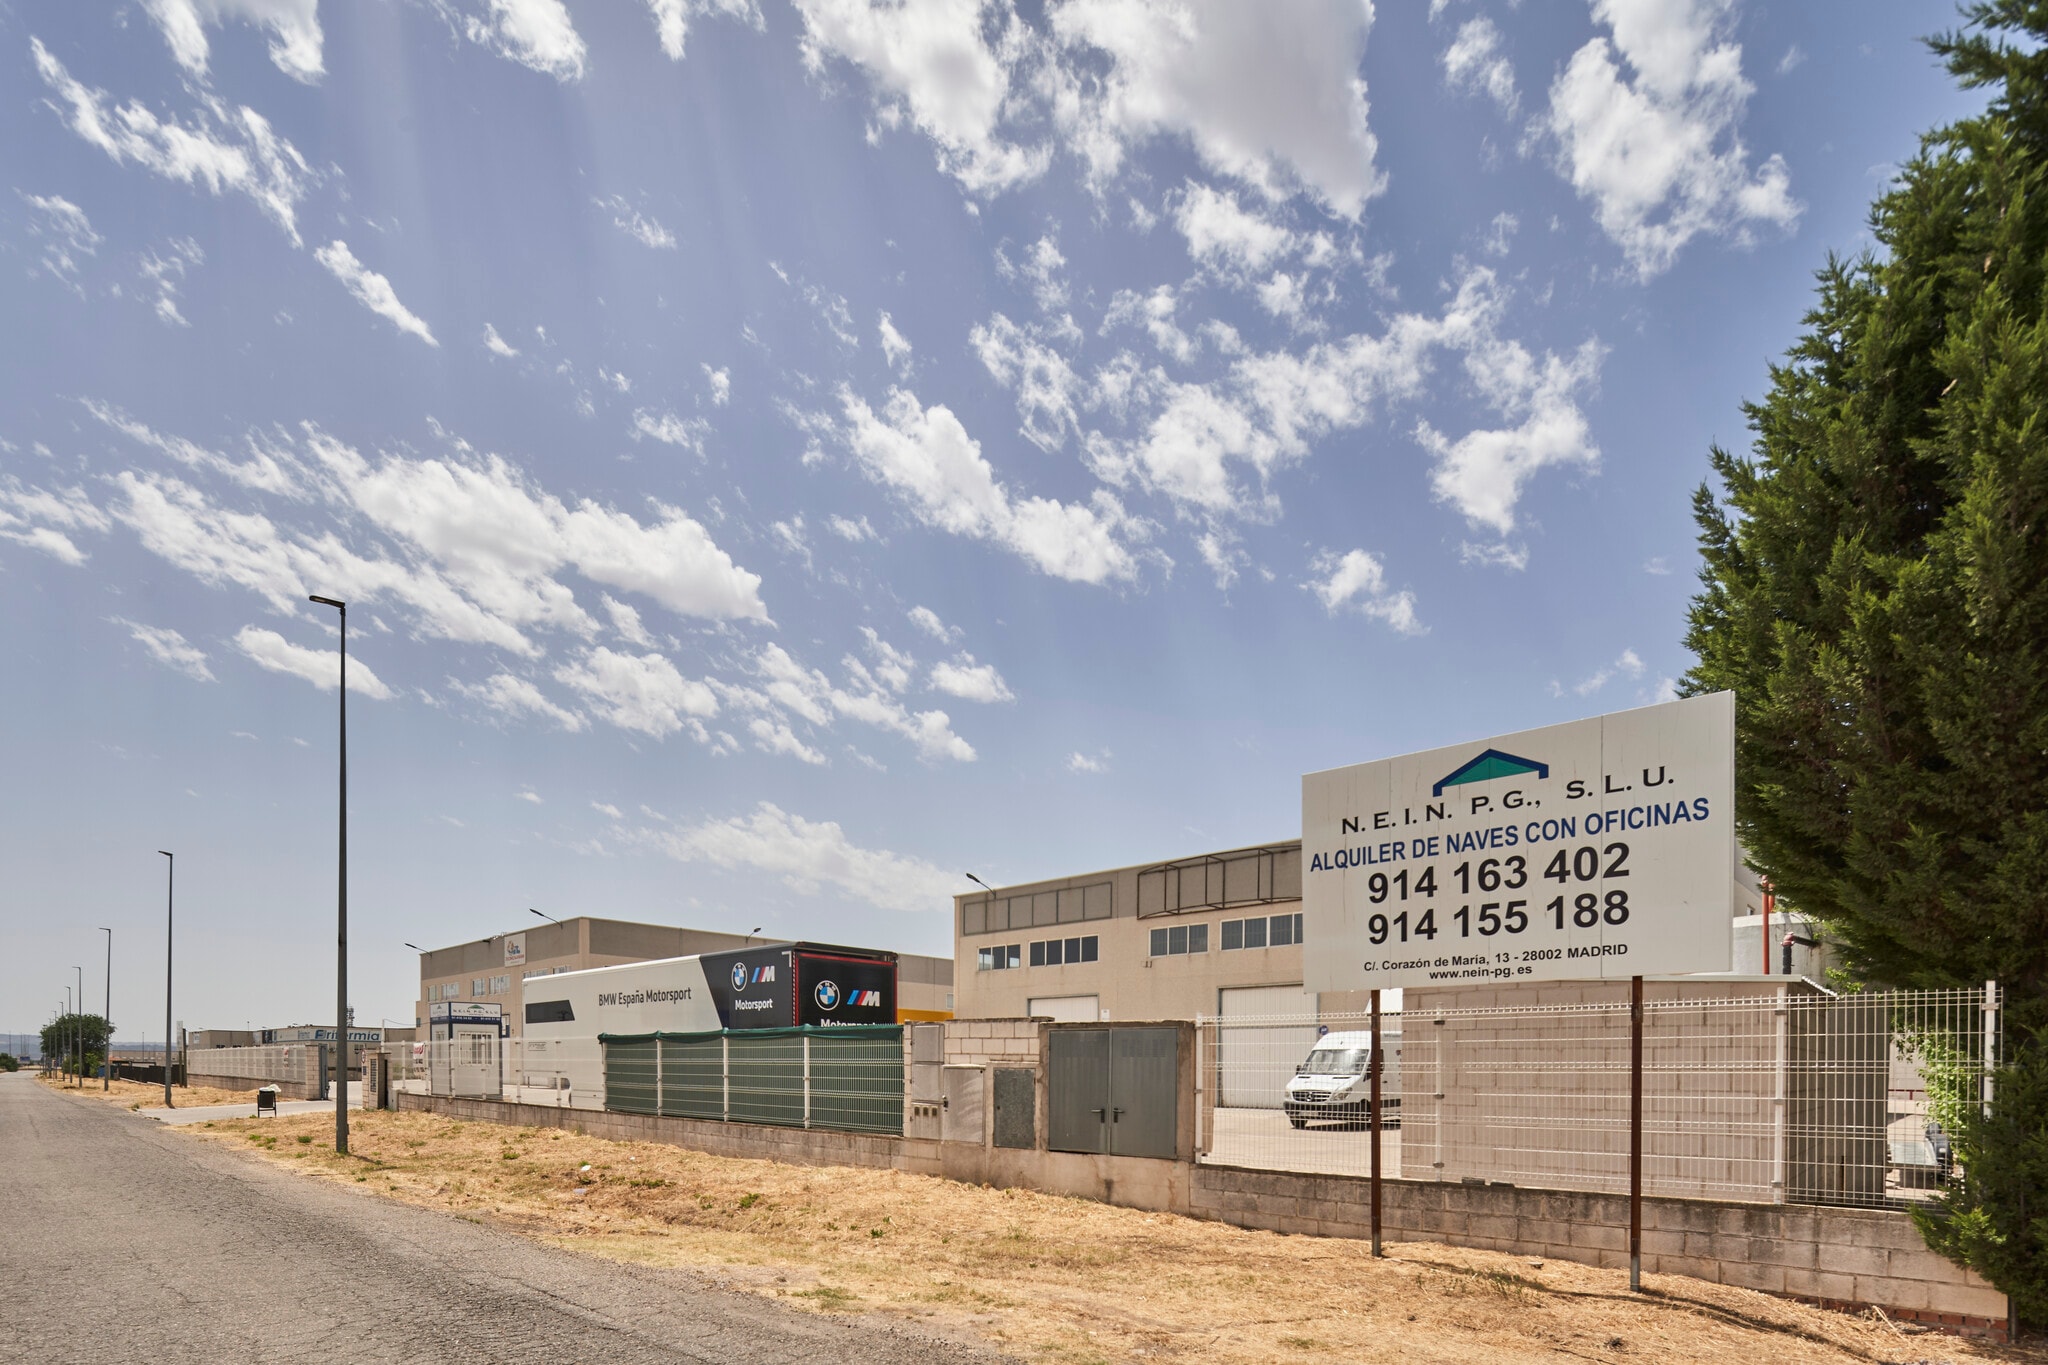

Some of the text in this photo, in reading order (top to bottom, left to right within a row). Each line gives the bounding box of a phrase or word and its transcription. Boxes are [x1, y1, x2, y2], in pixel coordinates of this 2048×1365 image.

[1310, 797, 1709, 872] ALQUILER DE NAVES CON OFICINAS
[1368, 842, 1630, 904] 914 163 402
[1368, 889, 1630, 945] 914 155 188
[1382, 958, 1430, 970] Corazón
[1434, 957, 1449, 967] de
[1452, 954, 1490, 966] María,
[1495, 952, 1510, 963] 13
[1522, 948, 1562, 961] 28002
[1567, 944, 1628, 958] MADRID
[598, 987, 692, 1008] BMW España Motorsport
[735, 998, 774, 1012] Motorsport
[314, 1029, 380, 1041] Frirmia
